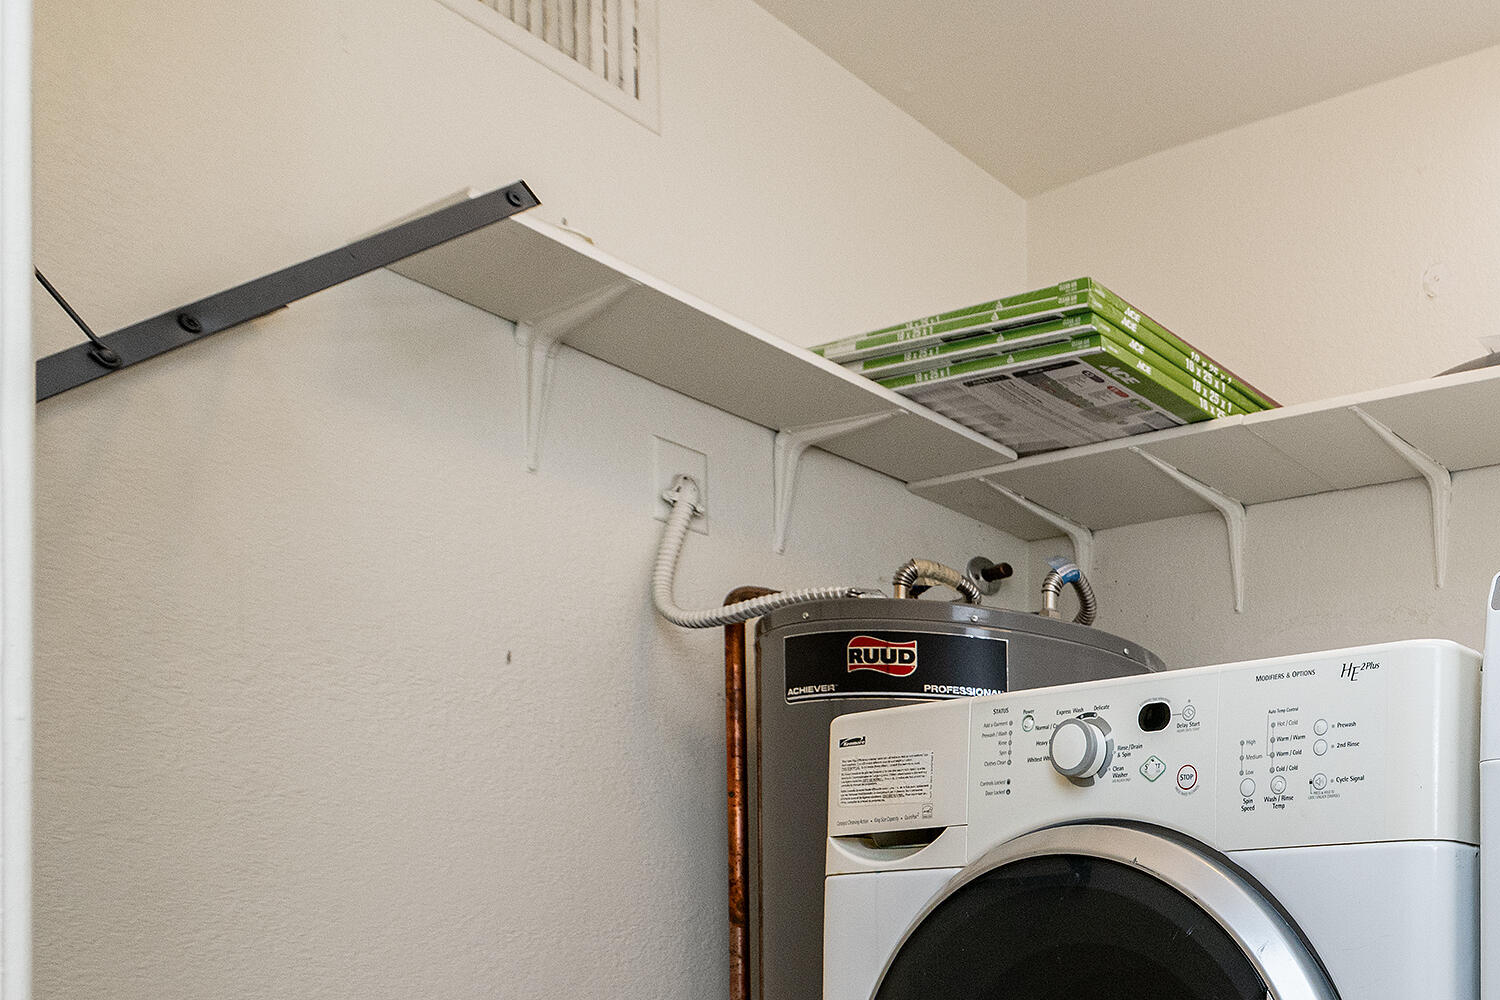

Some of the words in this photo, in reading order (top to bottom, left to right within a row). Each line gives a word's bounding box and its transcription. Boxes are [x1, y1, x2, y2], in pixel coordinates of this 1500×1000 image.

[1099, 364, 1141, 387] ACE
[1203, 369, 1213, 384] 25
[1209, 390, 1220, 405] 25
[848, 647, 916, 665] RUUD
[787, 684, 835, 696] ACHIEVER
[1336, 721, 1356, 729] Prewash
[1180, 773, 1194, 781] STOP
[1349, 775, 1365, 783] Signal
[1281, 794, 1294, 802] Rinse
